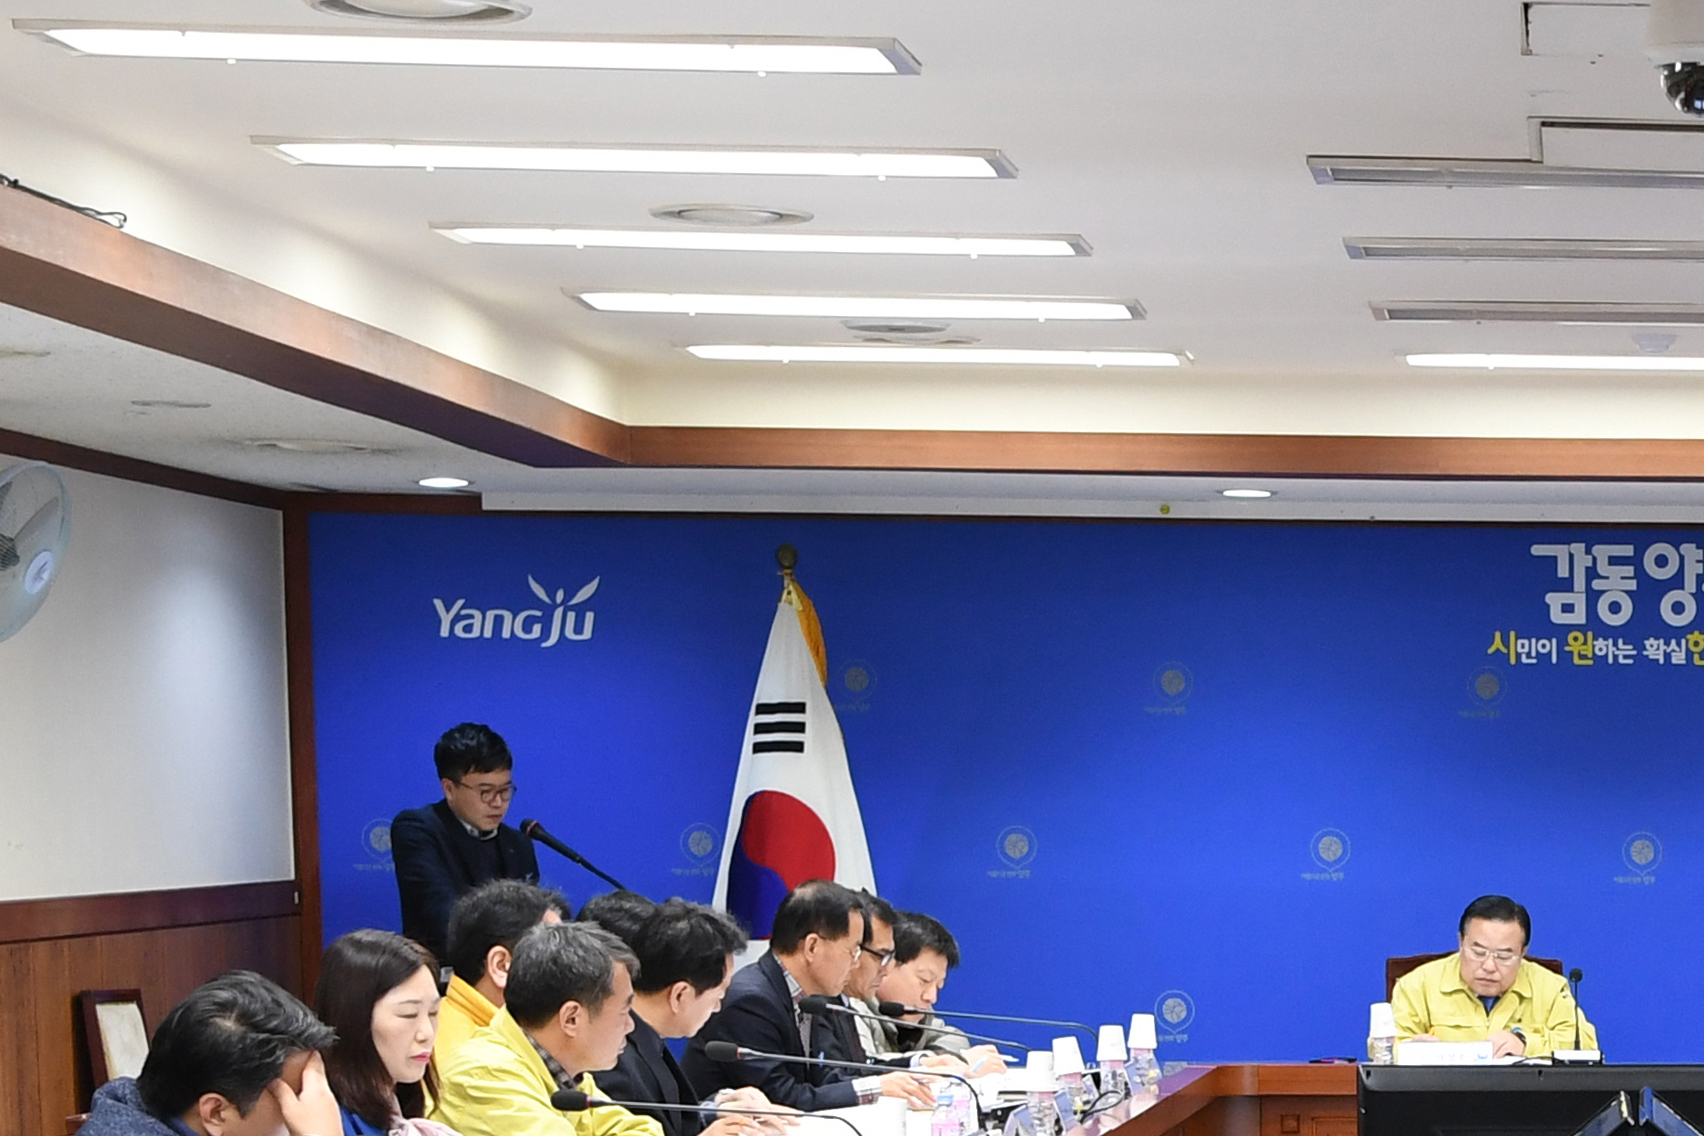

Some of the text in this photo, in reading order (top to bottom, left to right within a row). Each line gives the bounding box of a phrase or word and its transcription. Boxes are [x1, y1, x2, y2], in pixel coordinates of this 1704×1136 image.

[1530, 542, 1638, 627] 감동
[1487, 630, 1558, 666] 시민이
[1564, 630, 1638, 666] 원하는
